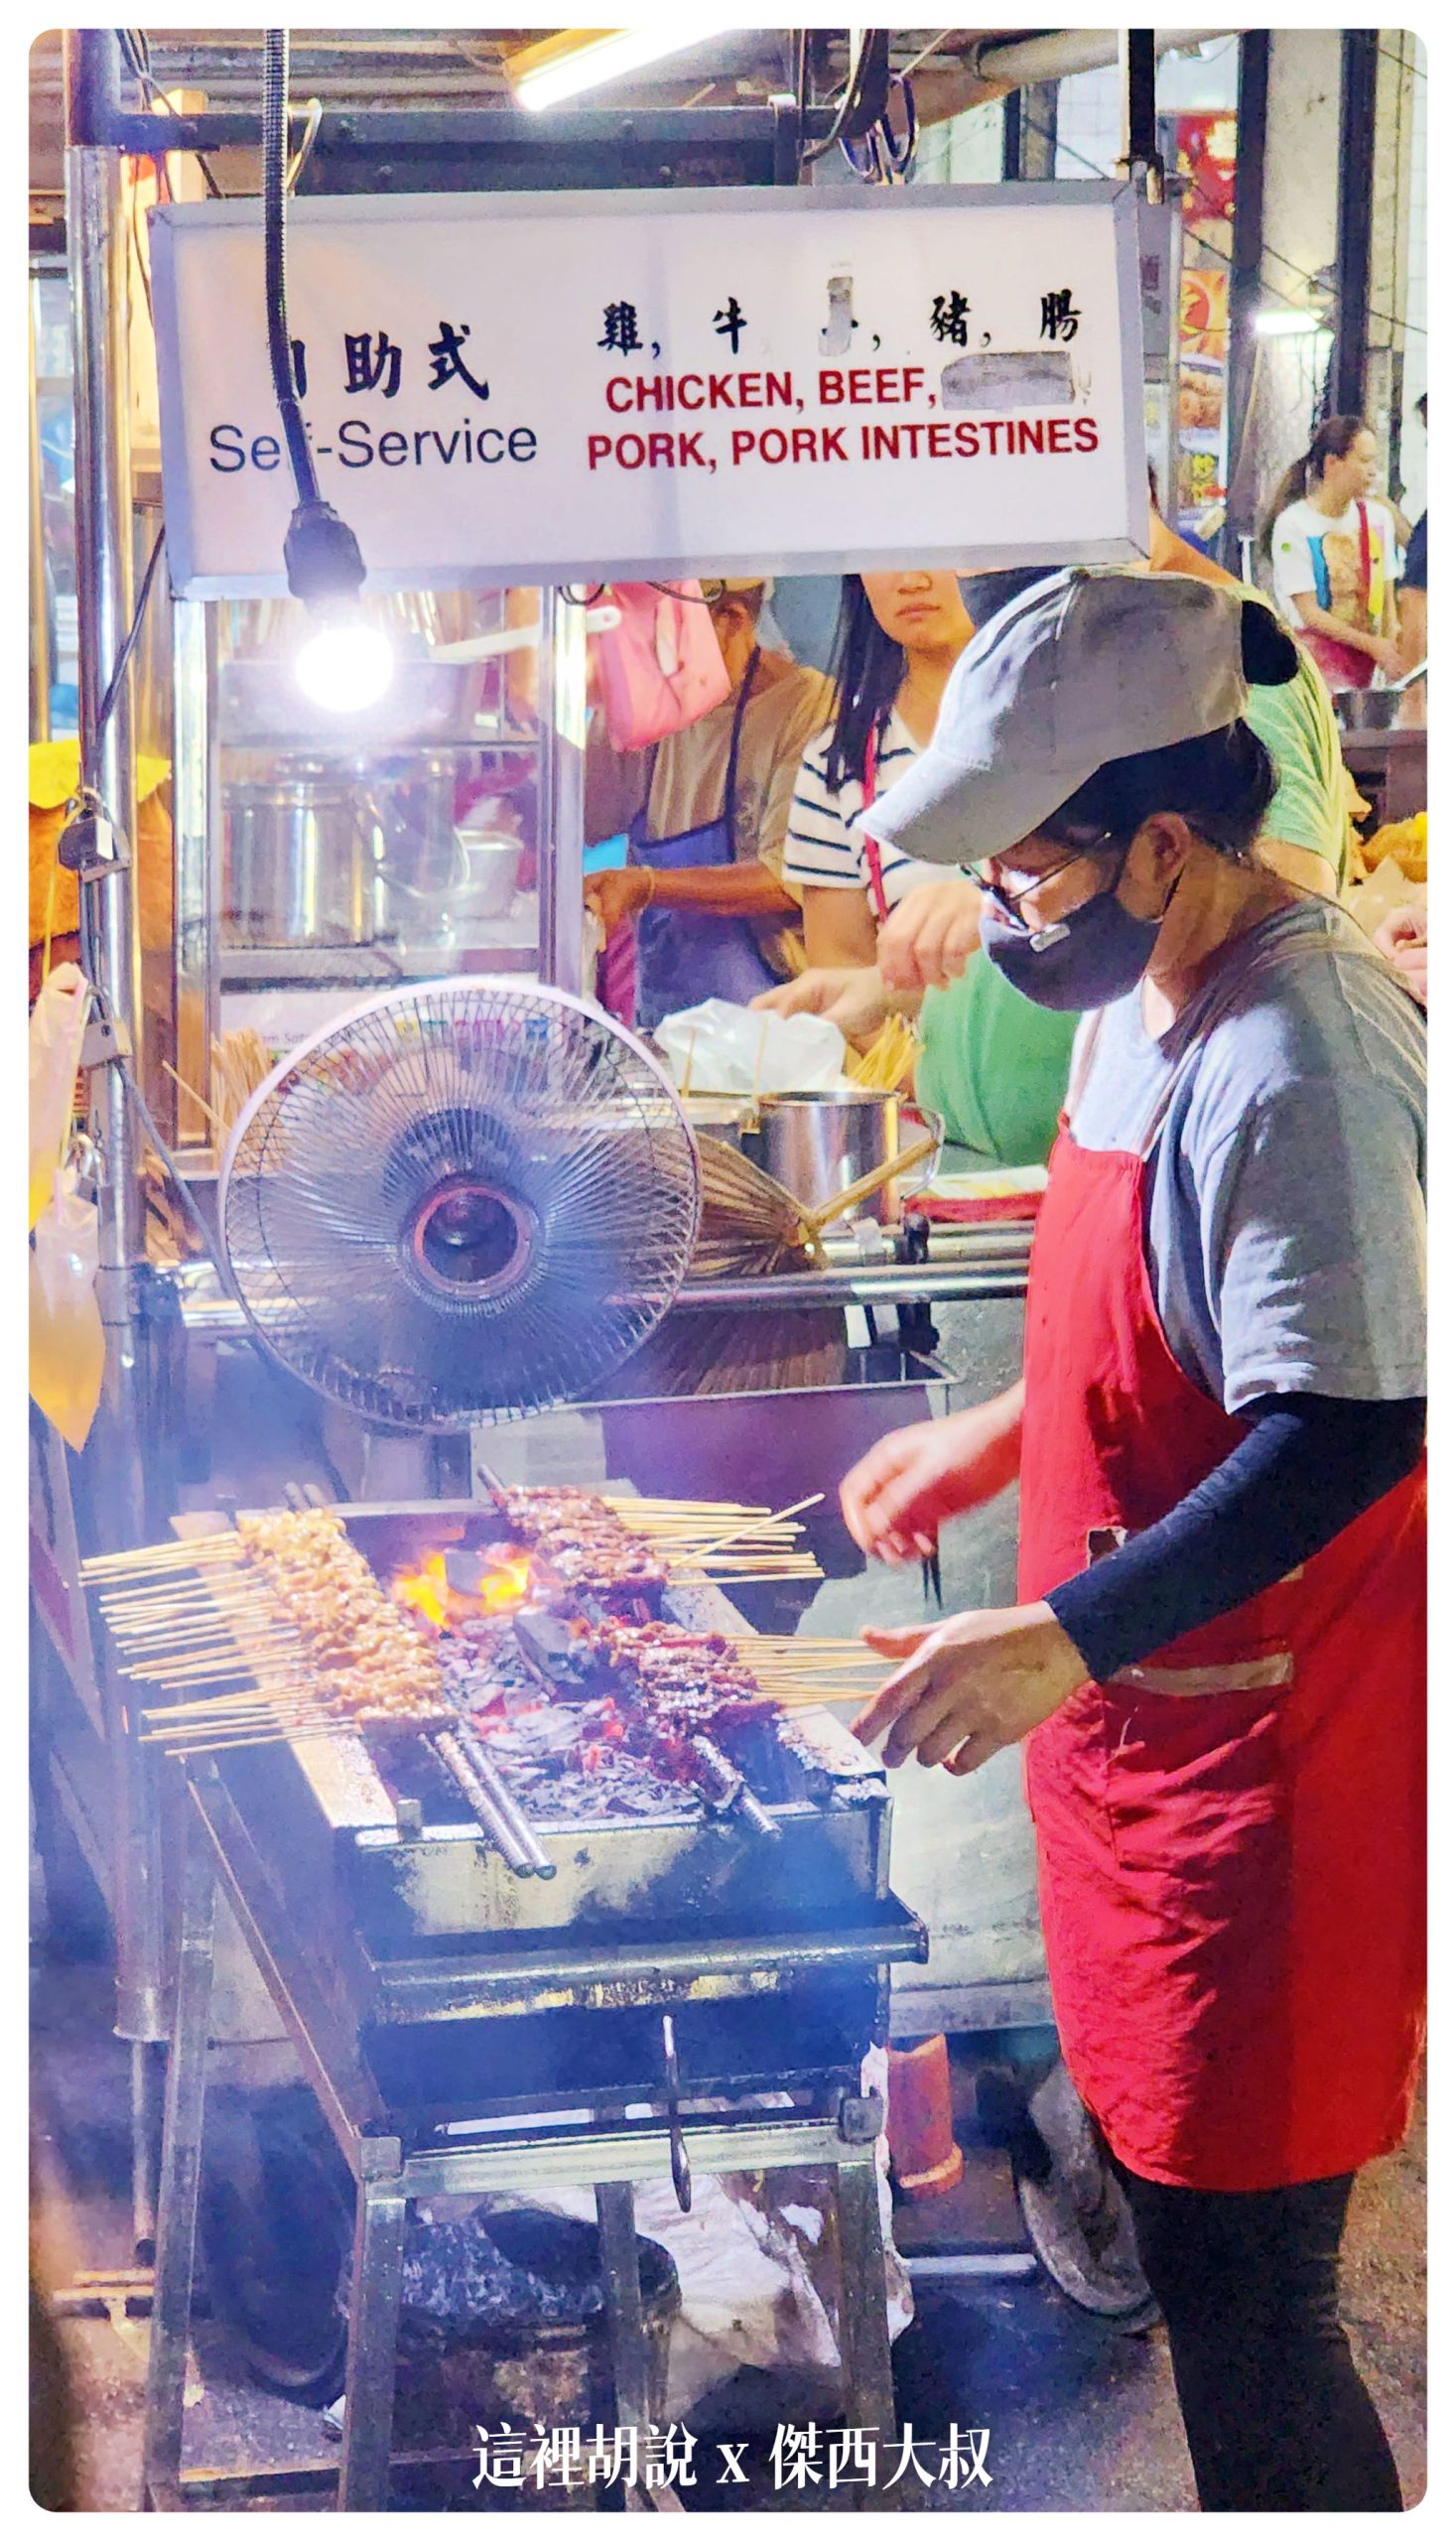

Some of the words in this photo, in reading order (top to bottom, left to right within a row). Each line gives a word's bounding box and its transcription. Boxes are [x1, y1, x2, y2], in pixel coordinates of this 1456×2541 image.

[1040, 288, 1082, 342] 腸
[605, 370, 805, 415] CHICKEN,
[818, 366, 937, 409] BEEF,
[209, 417, 538, 473] Se-Service
[587, 431, 717, 474] PORK,
[730, 426, 848, 467] PORK
[860, 416, 1100, 461] INTESTINES
